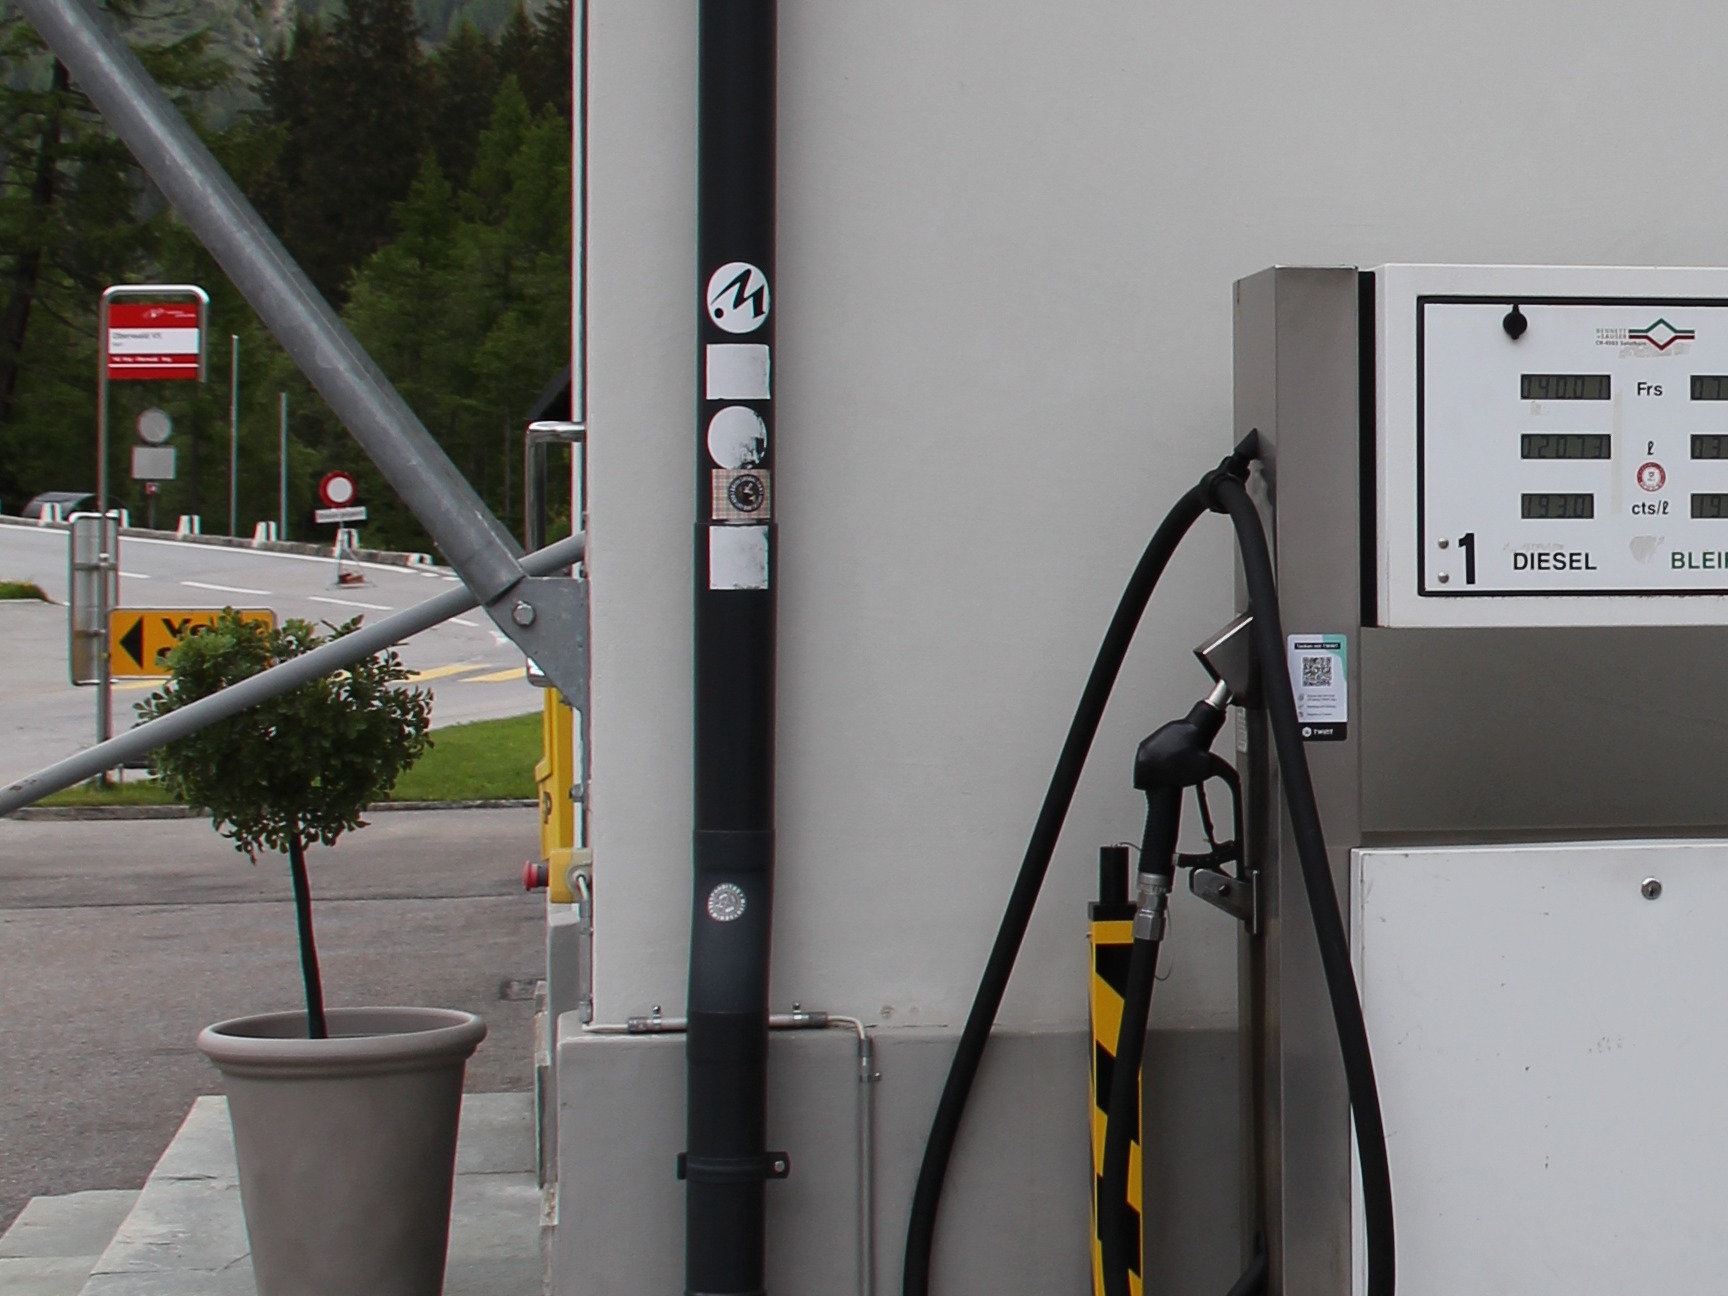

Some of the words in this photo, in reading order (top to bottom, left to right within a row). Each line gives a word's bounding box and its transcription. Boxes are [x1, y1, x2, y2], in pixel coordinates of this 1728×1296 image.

[1637, 382, 1663, 396] Frs
[1458, 532, 1475, 585] 1
[1513, 552, 1597, 570] DIESEL
